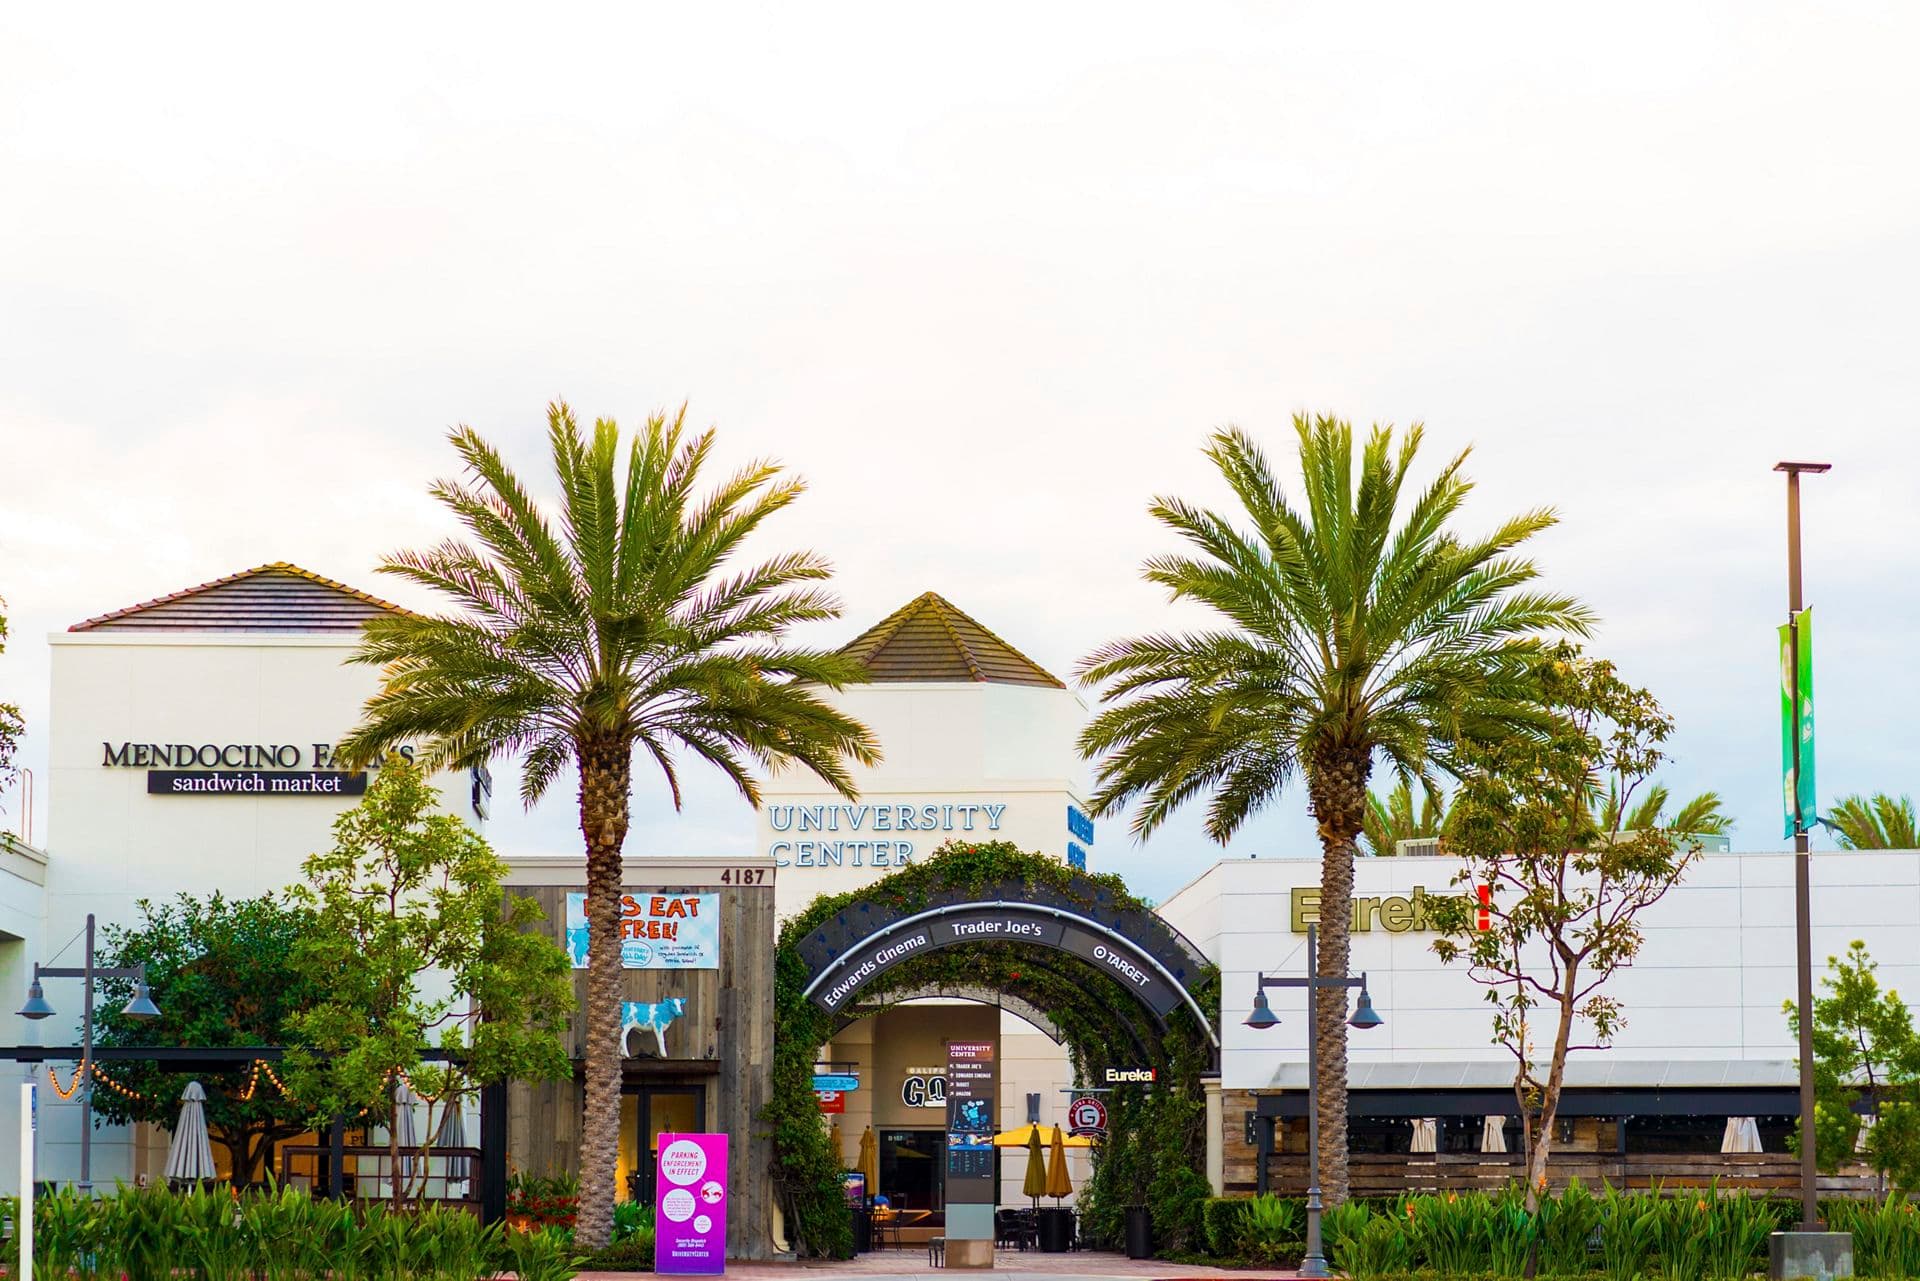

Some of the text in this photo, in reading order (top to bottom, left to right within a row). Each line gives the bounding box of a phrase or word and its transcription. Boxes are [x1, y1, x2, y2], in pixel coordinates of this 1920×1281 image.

[102, 742, 300, 768] MENDOCINO
[172, 772, 342, 792] sandwich market
[769, 804, 1006, 831] UNIVERSITY
[769, 840, 918, 867] CENTER
[721, 869, 765, 884] 4187
[650, 897, 700, 918] EAT
[619, 919, 678, 942] FREE!
[951, 921, 1042, 936] Trader Joe's
[824, 933, 926, 1007] Edwards Cinema
[1105, 951, 1151, 987] TARGET
[1106, 1068, 1156, 1082] Eureka!
[671, 1151, 698, 1159] PARKING
[676, 1168, 699, 1176] EFFECT
